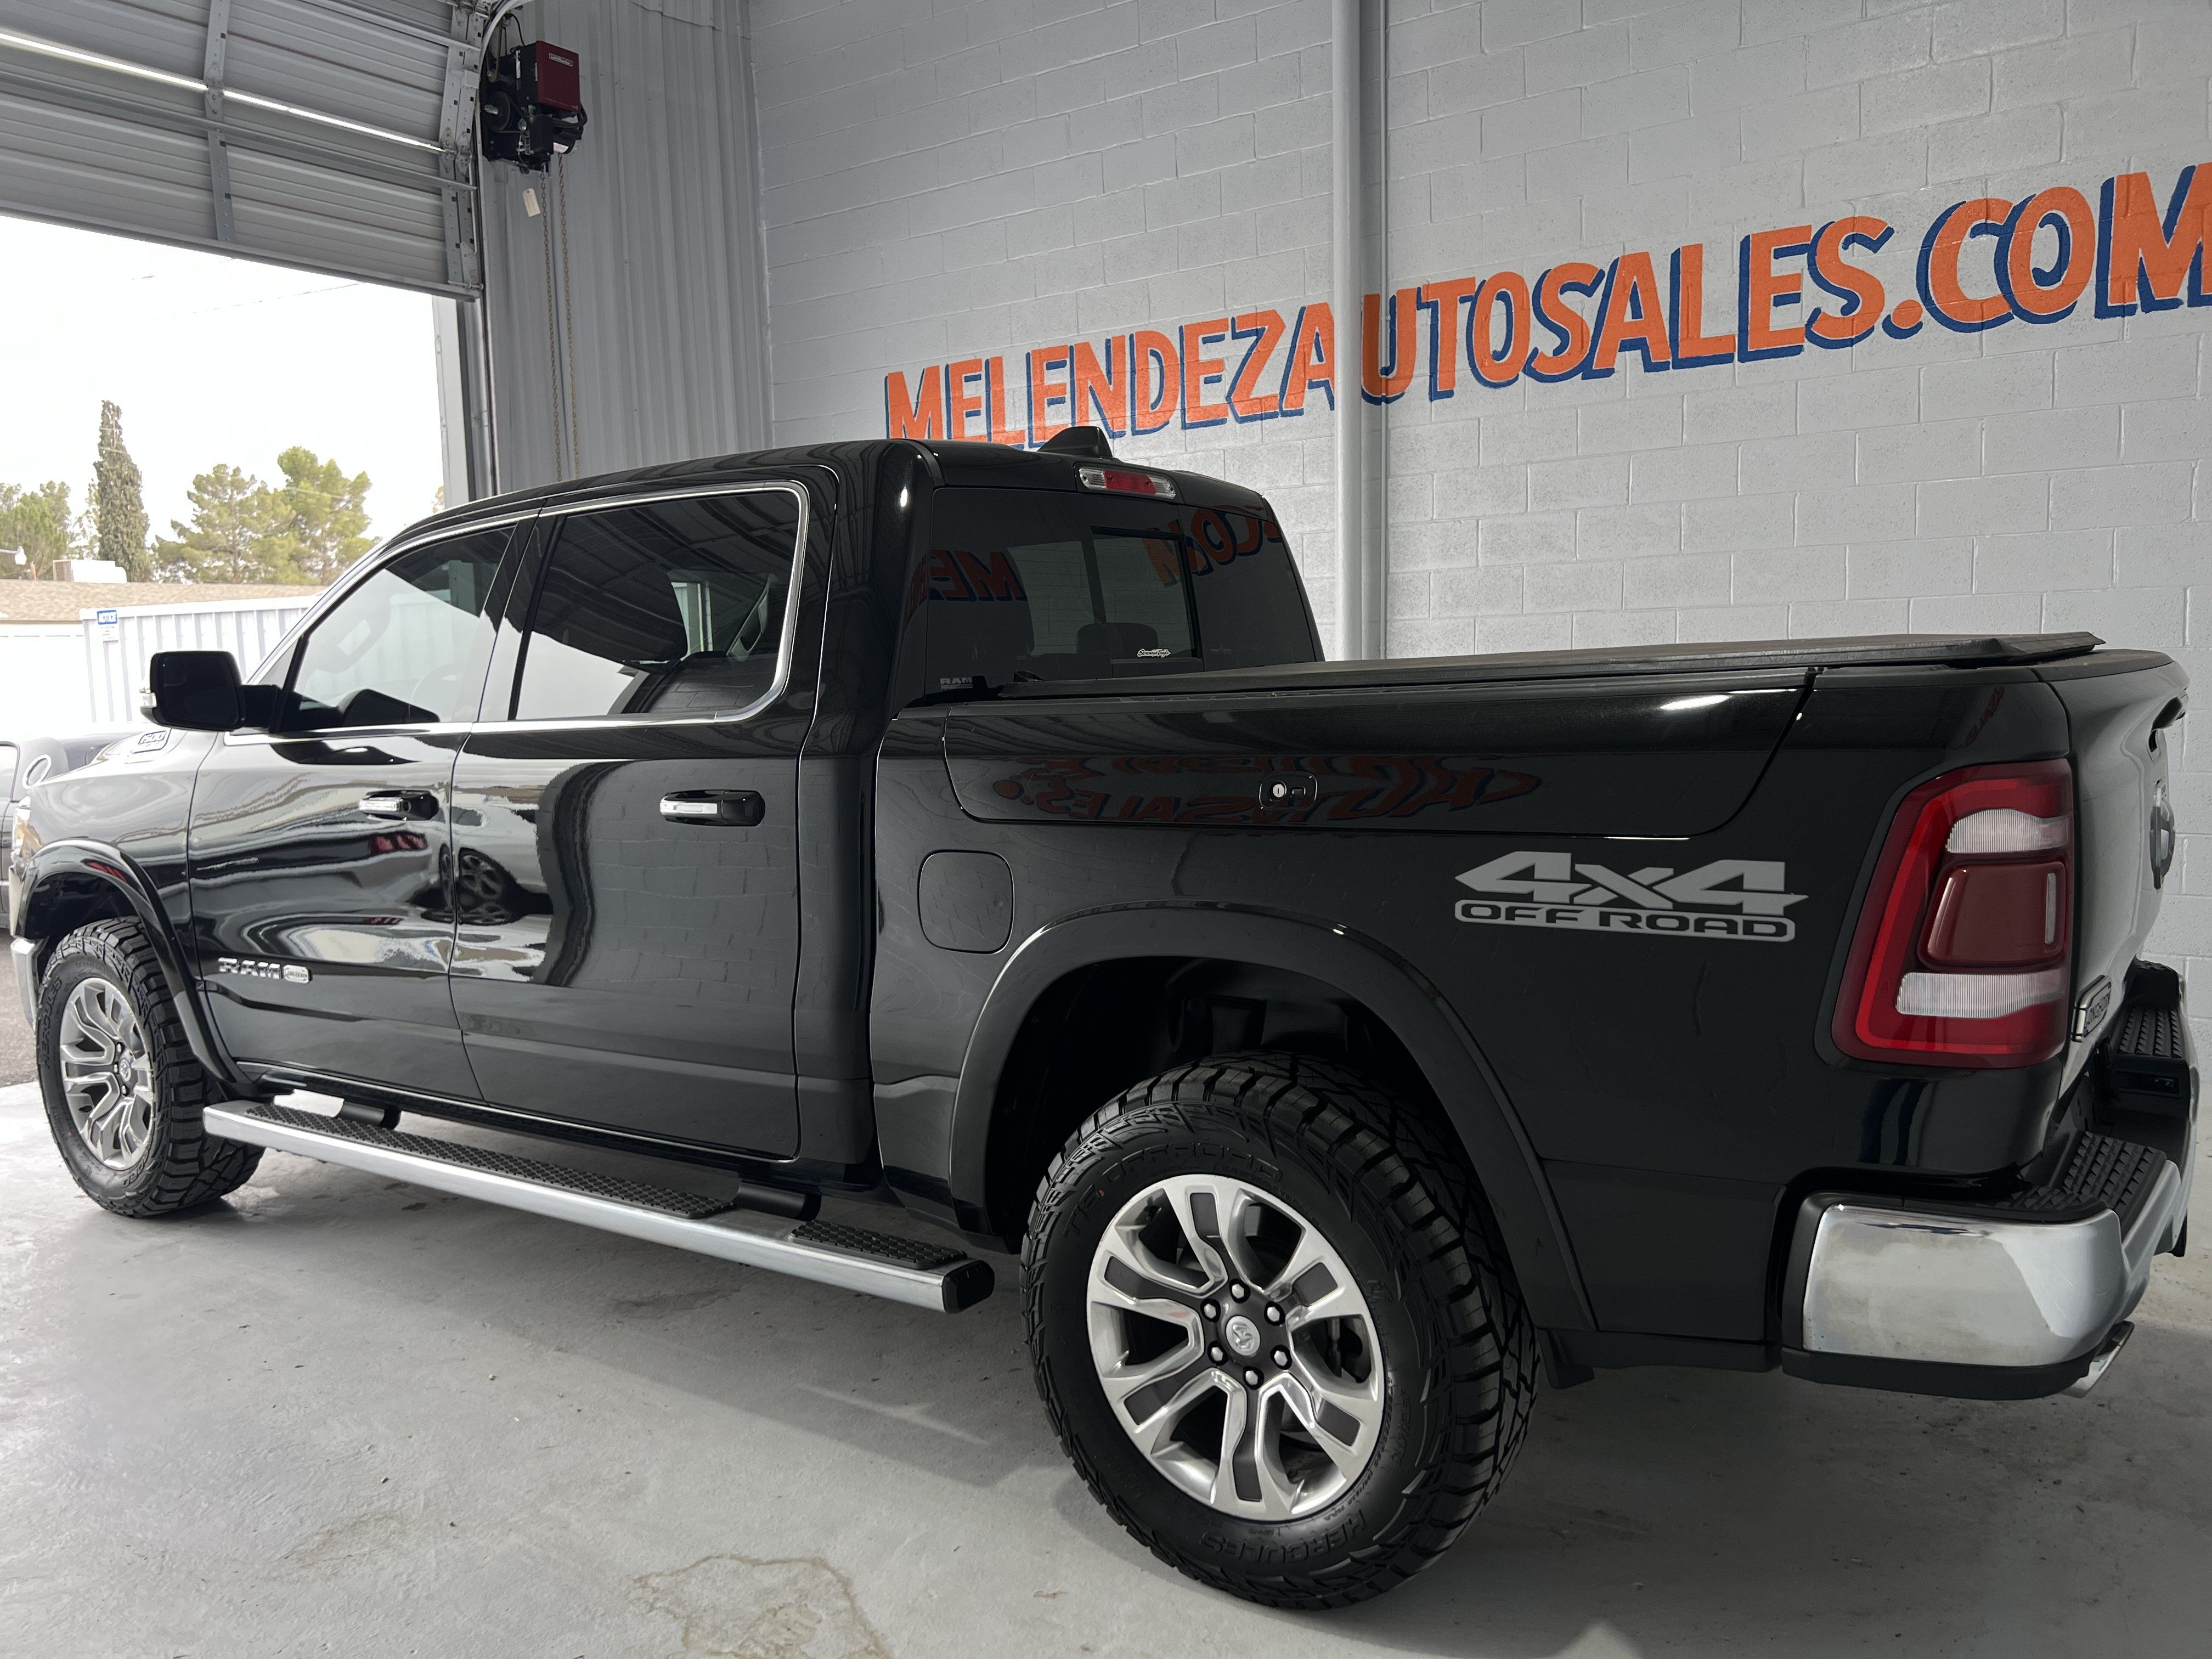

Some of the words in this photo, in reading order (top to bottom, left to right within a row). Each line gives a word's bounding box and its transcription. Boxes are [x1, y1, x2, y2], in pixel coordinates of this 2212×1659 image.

[1460, 904, 1588, 924] OFF
[1599, 910, 1788, 936] ROAD
[218, 957, 281, 979] RAM
[1200, 1508, 1368, 1564] HERCULES
